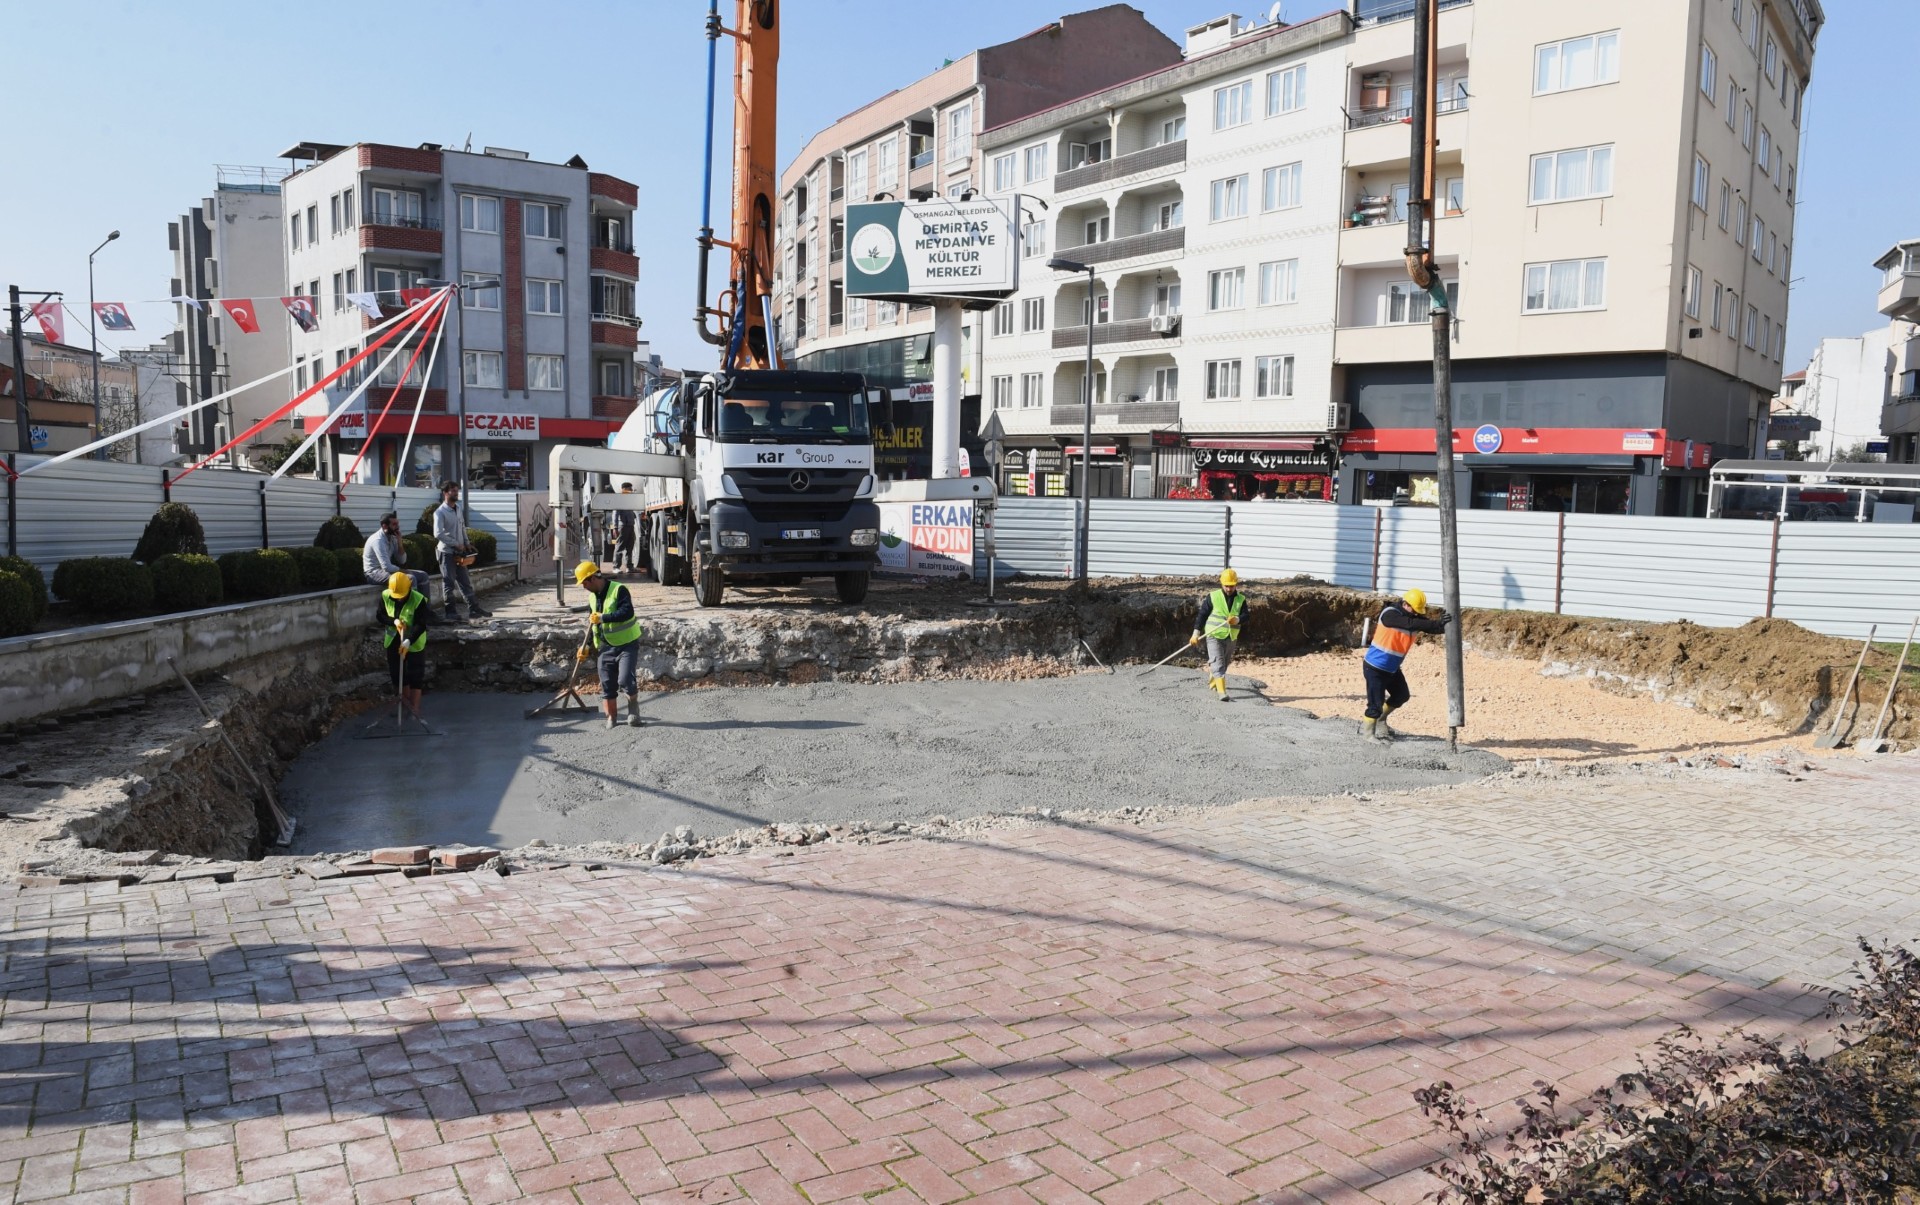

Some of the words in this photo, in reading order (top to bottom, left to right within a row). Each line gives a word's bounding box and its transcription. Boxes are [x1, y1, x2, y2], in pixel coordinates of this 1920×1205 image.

[913, 210, 956, 219] OSMANGAZİ
[957, 206, 998, 216] BELEDİYESİ
[922, 221, 988, 235] DEMİRTAŞ
[915, 237, 975, 250] MEYDANI
[979, 234, 995, 246] VE
[929, 249, 979, 263] KÜLTÜR
[926, 264, 982, 278] MERKEZİ
[465, 414, 536, 430] ECZANE
[487, 429, 513, 439] GÜLEÇ
[1477, 433, 1498, 444] seç
[802, 452, 834, 464] Group
[1217, 449, 1245, 463] Gold
[1250, 451, 1328, 469] Kuyumculuk
[912, 505, 972, 527] ERKAN
[914, 528, 968, 551] AYDIN
